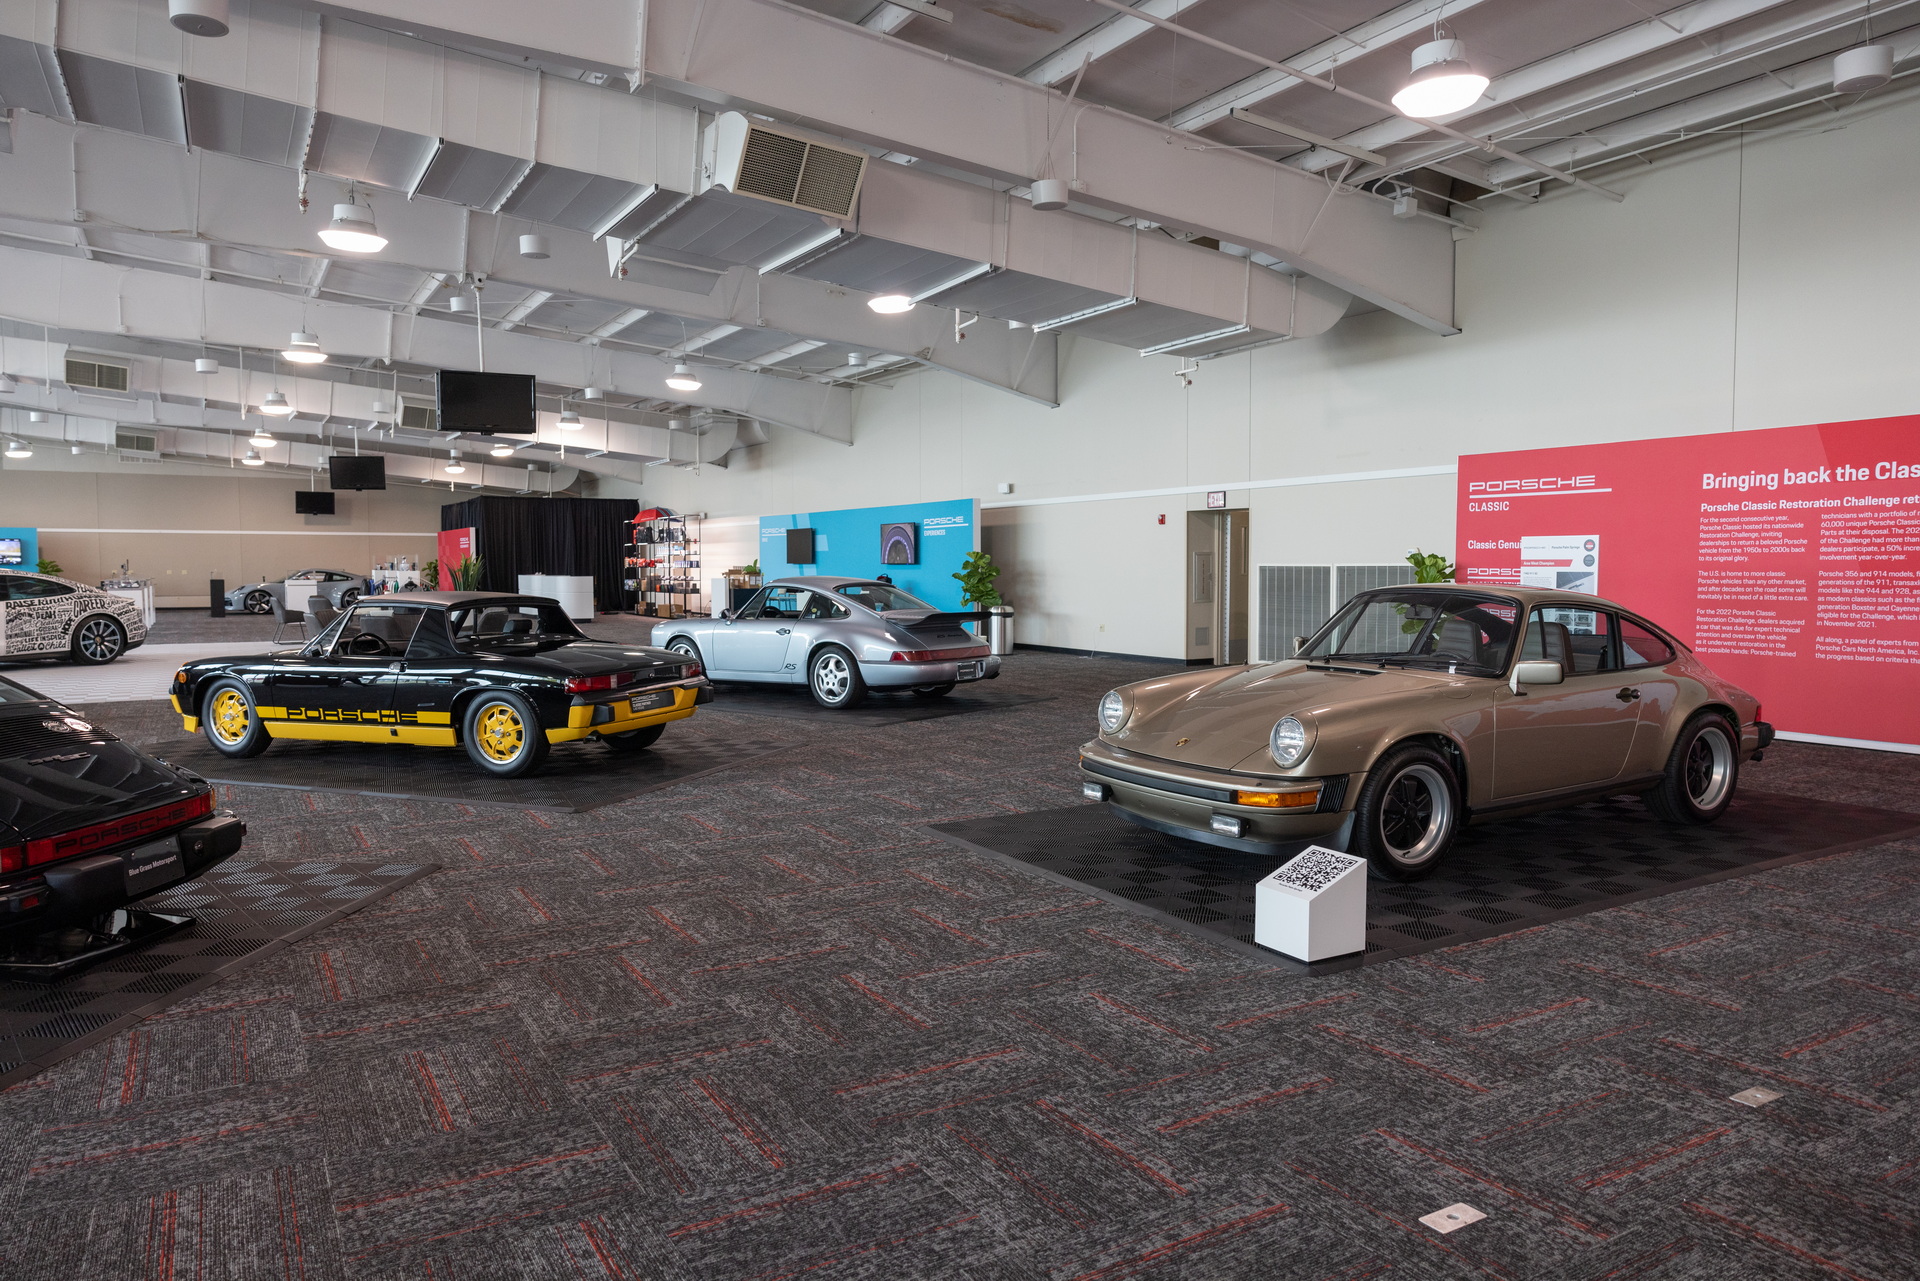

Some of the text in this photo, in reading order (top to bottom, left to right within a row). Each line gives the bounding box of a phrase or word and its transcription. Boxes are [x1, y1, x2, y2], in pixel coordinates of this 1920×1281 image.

[1470, 476, 1595, 492] PORSCHE
[1703, 471, 1778, 491] Bringing
[1784, 466, 1830, 484] back
[1836, 464, 1869, 481] the
[1469, 502, 1509, 511] CLASSIC
[1701, 503, 1739, 512] Porsche
[1742, 501, 1776, 510] Classic
[1780, 499, 1840, 508] Restoration
[1844, 496, 1900, 507] Challenge
[924, 516, 964, 525] PORSCHE
[1468, 540, 1496, 549] Classic
[6, 600, 37, 610] RAISE
[74, 599, 108, 618] CAREER
[287, 707, 418, 723] PORSCHE
[55, 807, 186, 854] PORSCHE
[129, 855, 177, 876] Blue Grass Motorsport
